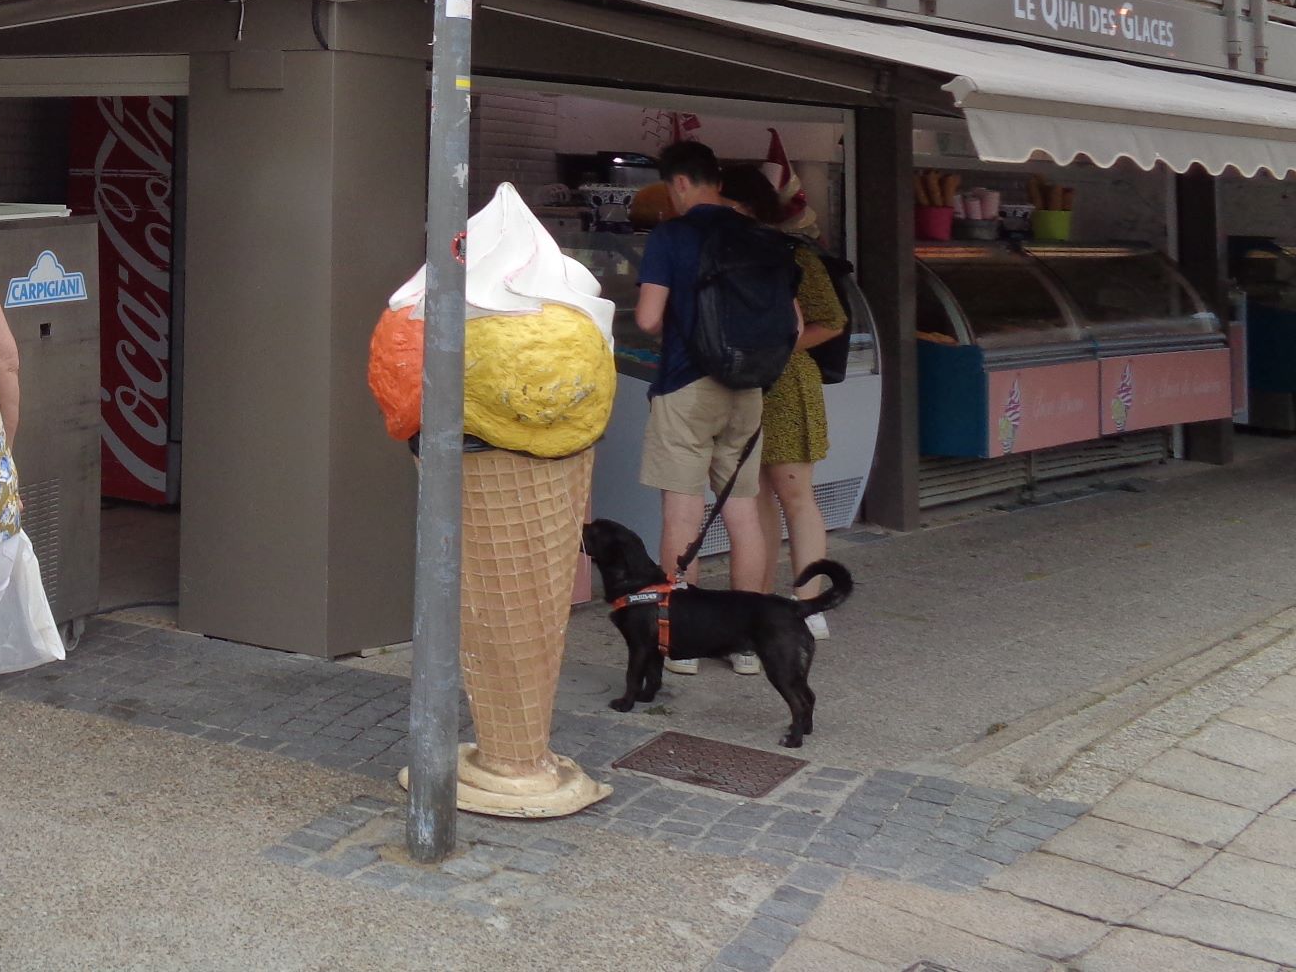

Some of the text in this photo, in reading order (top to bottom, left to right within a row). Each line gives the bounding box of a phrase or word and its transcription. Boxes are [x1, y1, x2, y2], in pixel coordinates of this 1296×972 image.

[1089, 4, 1116, 36] DES
[1120, 2, 1175, 48] GLACES
[11, 278, 80, 301] CARPIGIANI
